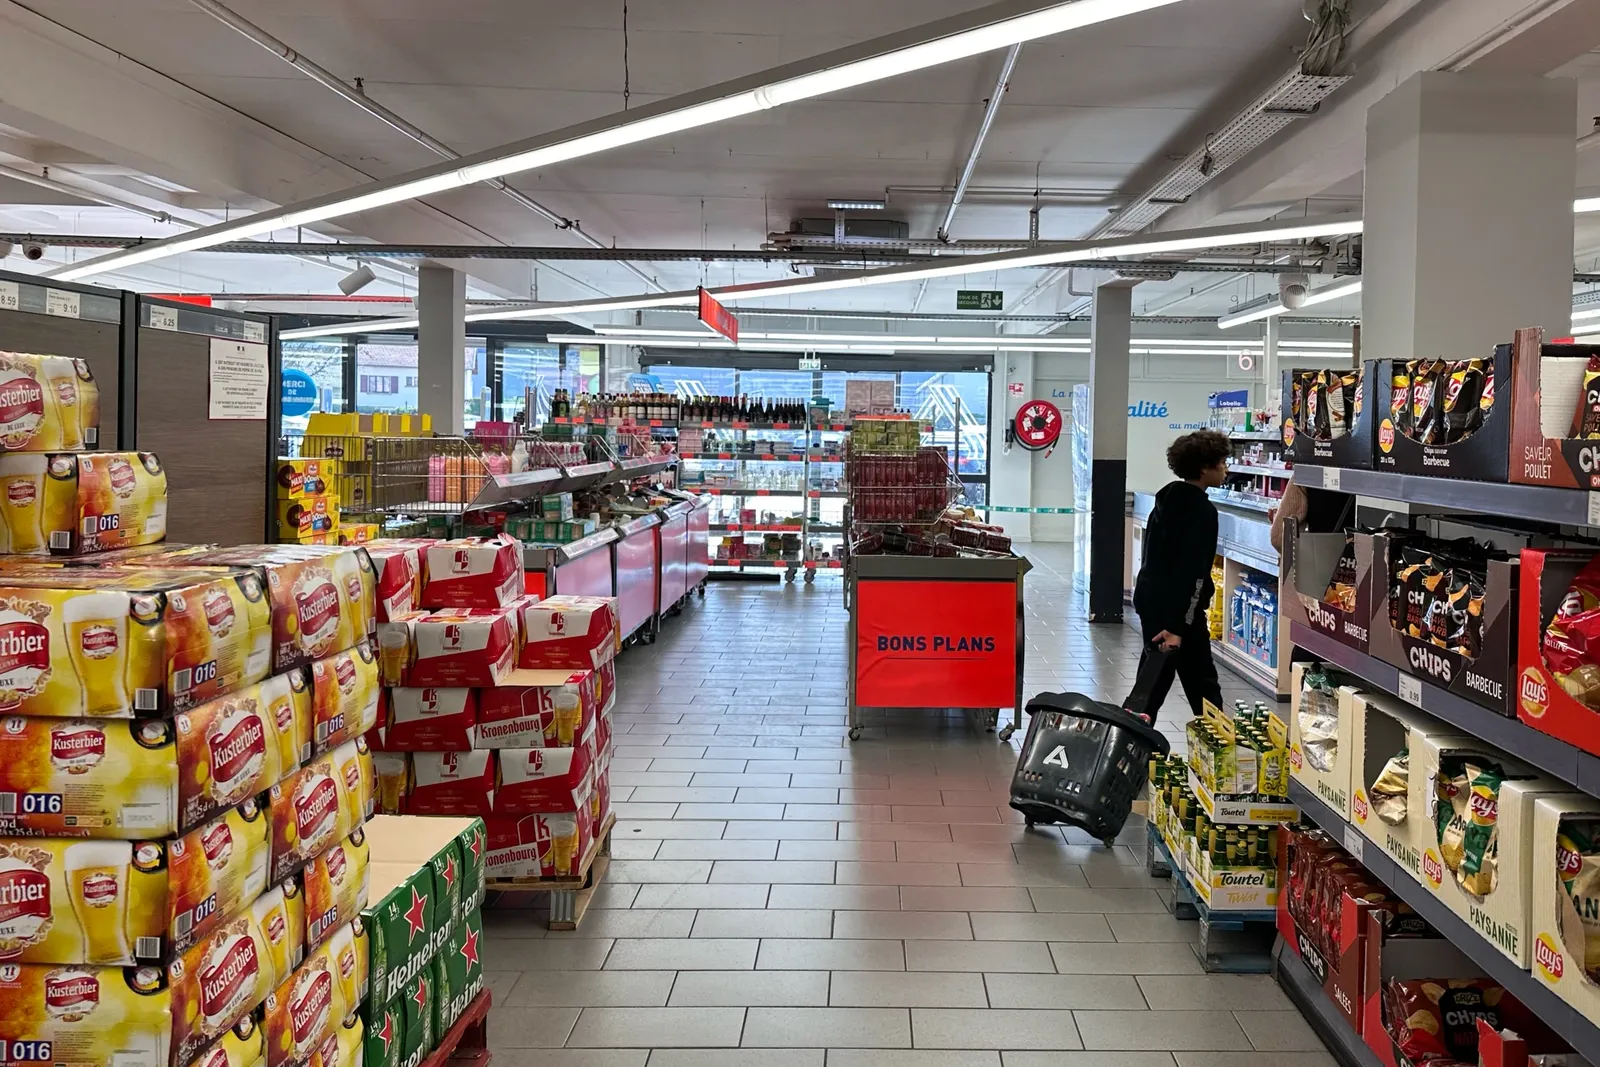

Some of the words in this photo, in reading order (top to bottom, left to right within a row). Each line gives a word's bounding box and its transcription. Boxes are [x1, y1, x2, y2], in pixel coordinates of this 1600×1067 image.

[63, 303, 77, 314] 9.10
[1239, 349, 1252, 370] 6
[0, 385, 40, 408] sterbier
[1423, 456, 1450, 467] Barbecue
[1525, 446, 1551, 461] SAVEUR
[1525, 464, 1551, 479] POULET
[100, 515, 119, 530] 016
[301, 589, 337, 623] Kusterbier
[1309, 606, 1336, 632] CHIPS
[1344, 621, 1367, 643] BARBECUE
[877, 635, 927, 651] BONS
[933, 636, 996, 652] PLANS
[195, 660, 216, 684] 016
[1410, 645, 1451, 682] CHIPS
[1466, 671, 1502, 699] BARBECUE
[1522, 675, 1547, 703] Lay's
[329, 716, 344, 733] 016
[480, 718, 540, 740] Kronenbourg
[53, 736, 104, 750] Kusterbier
[214, 722, 261, 769] Kusterbier
[23, 795, 61, 812] 016
[299, 785, 335, 827] Kusterbier
[1318, 780, 1346, 813] PAYSANNE
[1220, 808, 1246, 816] Tourtel
[485, 846, 537, 868] ronenbourg
[1387, 834, 1420, 874] PAYSANNE
[1219, 872, 1264, 886] Tourtel
[1226, 892, 1259, 903] Twist
[196, 896, 216, 922] 016
[322, 906, 337, 929] 016
[389, 902, 397, 917] 14
[1470, 905, 1518, 957] PAYSANNE
[1299, 934, 1323, 976] CHIPS
[1537, 939, 1561, 973] Lay's
[205, 943, 254, 1003] Kusterbier
[47, 983, 97, 998] Kusterbier
[449, 973, 483, 1028] Heine
[294, 978, 330, 1032] Kusterbier
[1446, 1009, 1499, 1026] CHIPS
[13, 1043, 49, 1060] 016
